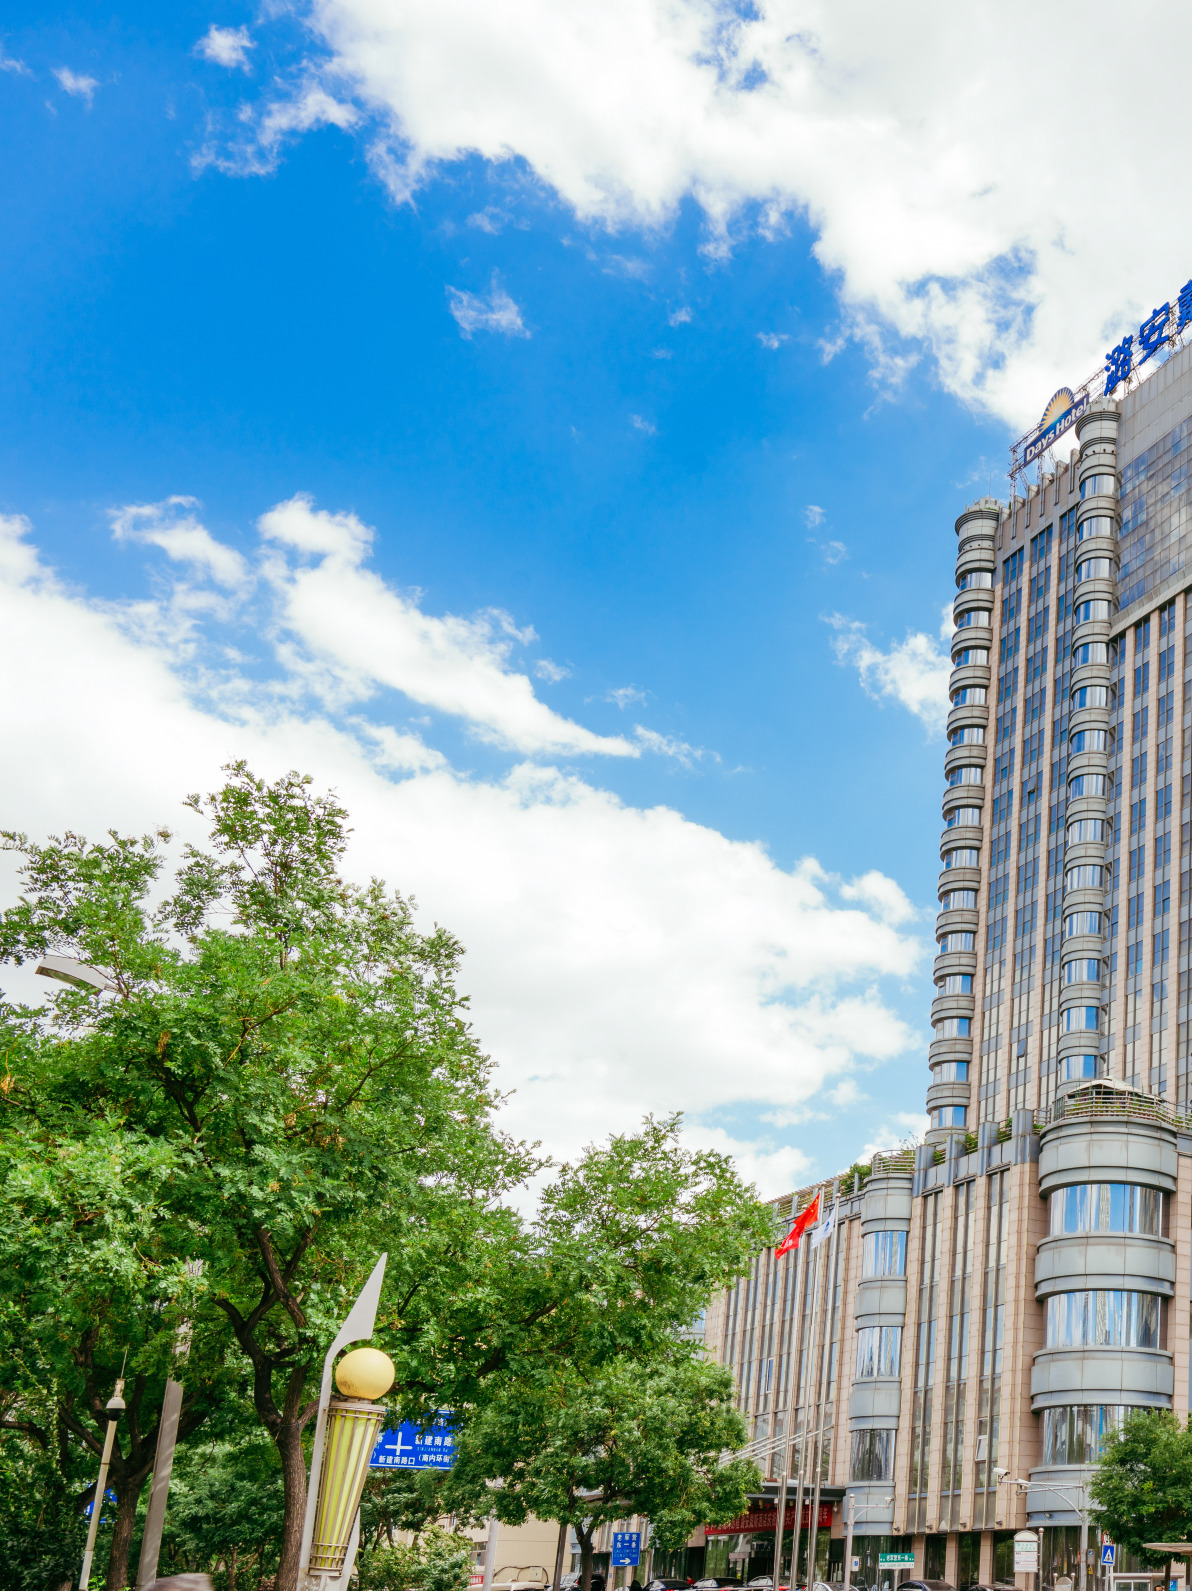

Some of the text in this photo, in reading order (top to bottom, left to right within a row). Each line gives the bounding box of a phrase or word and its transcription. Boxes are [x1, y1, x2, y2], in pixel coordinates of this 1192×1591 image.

[1026, 397, 1087, 461] Days Hotel
[378, 1455, 415, 1465] 新建南路口
